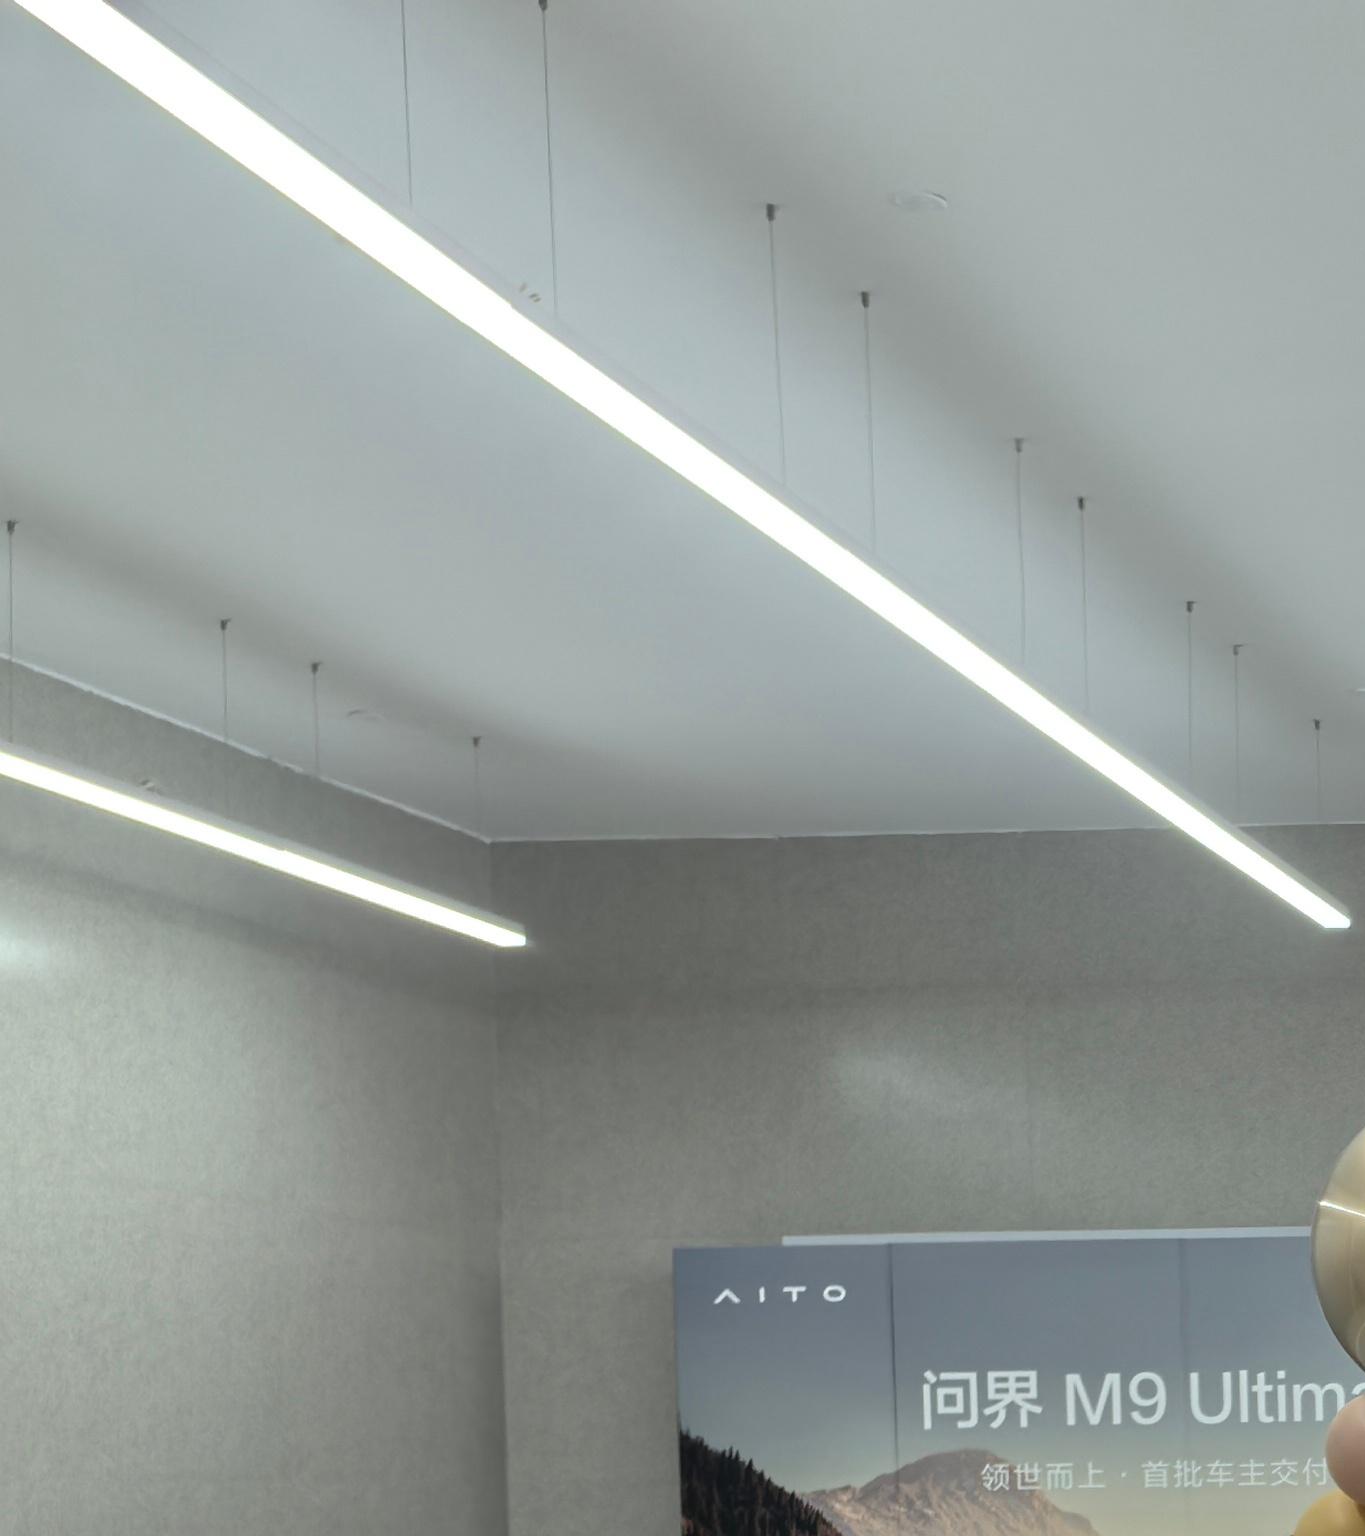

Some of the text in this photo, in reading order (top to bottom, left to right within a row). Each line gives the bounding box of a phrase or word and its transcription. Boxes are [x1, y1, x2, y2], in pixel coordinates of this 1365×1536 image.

[713, 1285, 846, 1304] AITO
[923, 1370, 1043, 1430] 问界
[1065, 1371, 1167, 1426] M9
